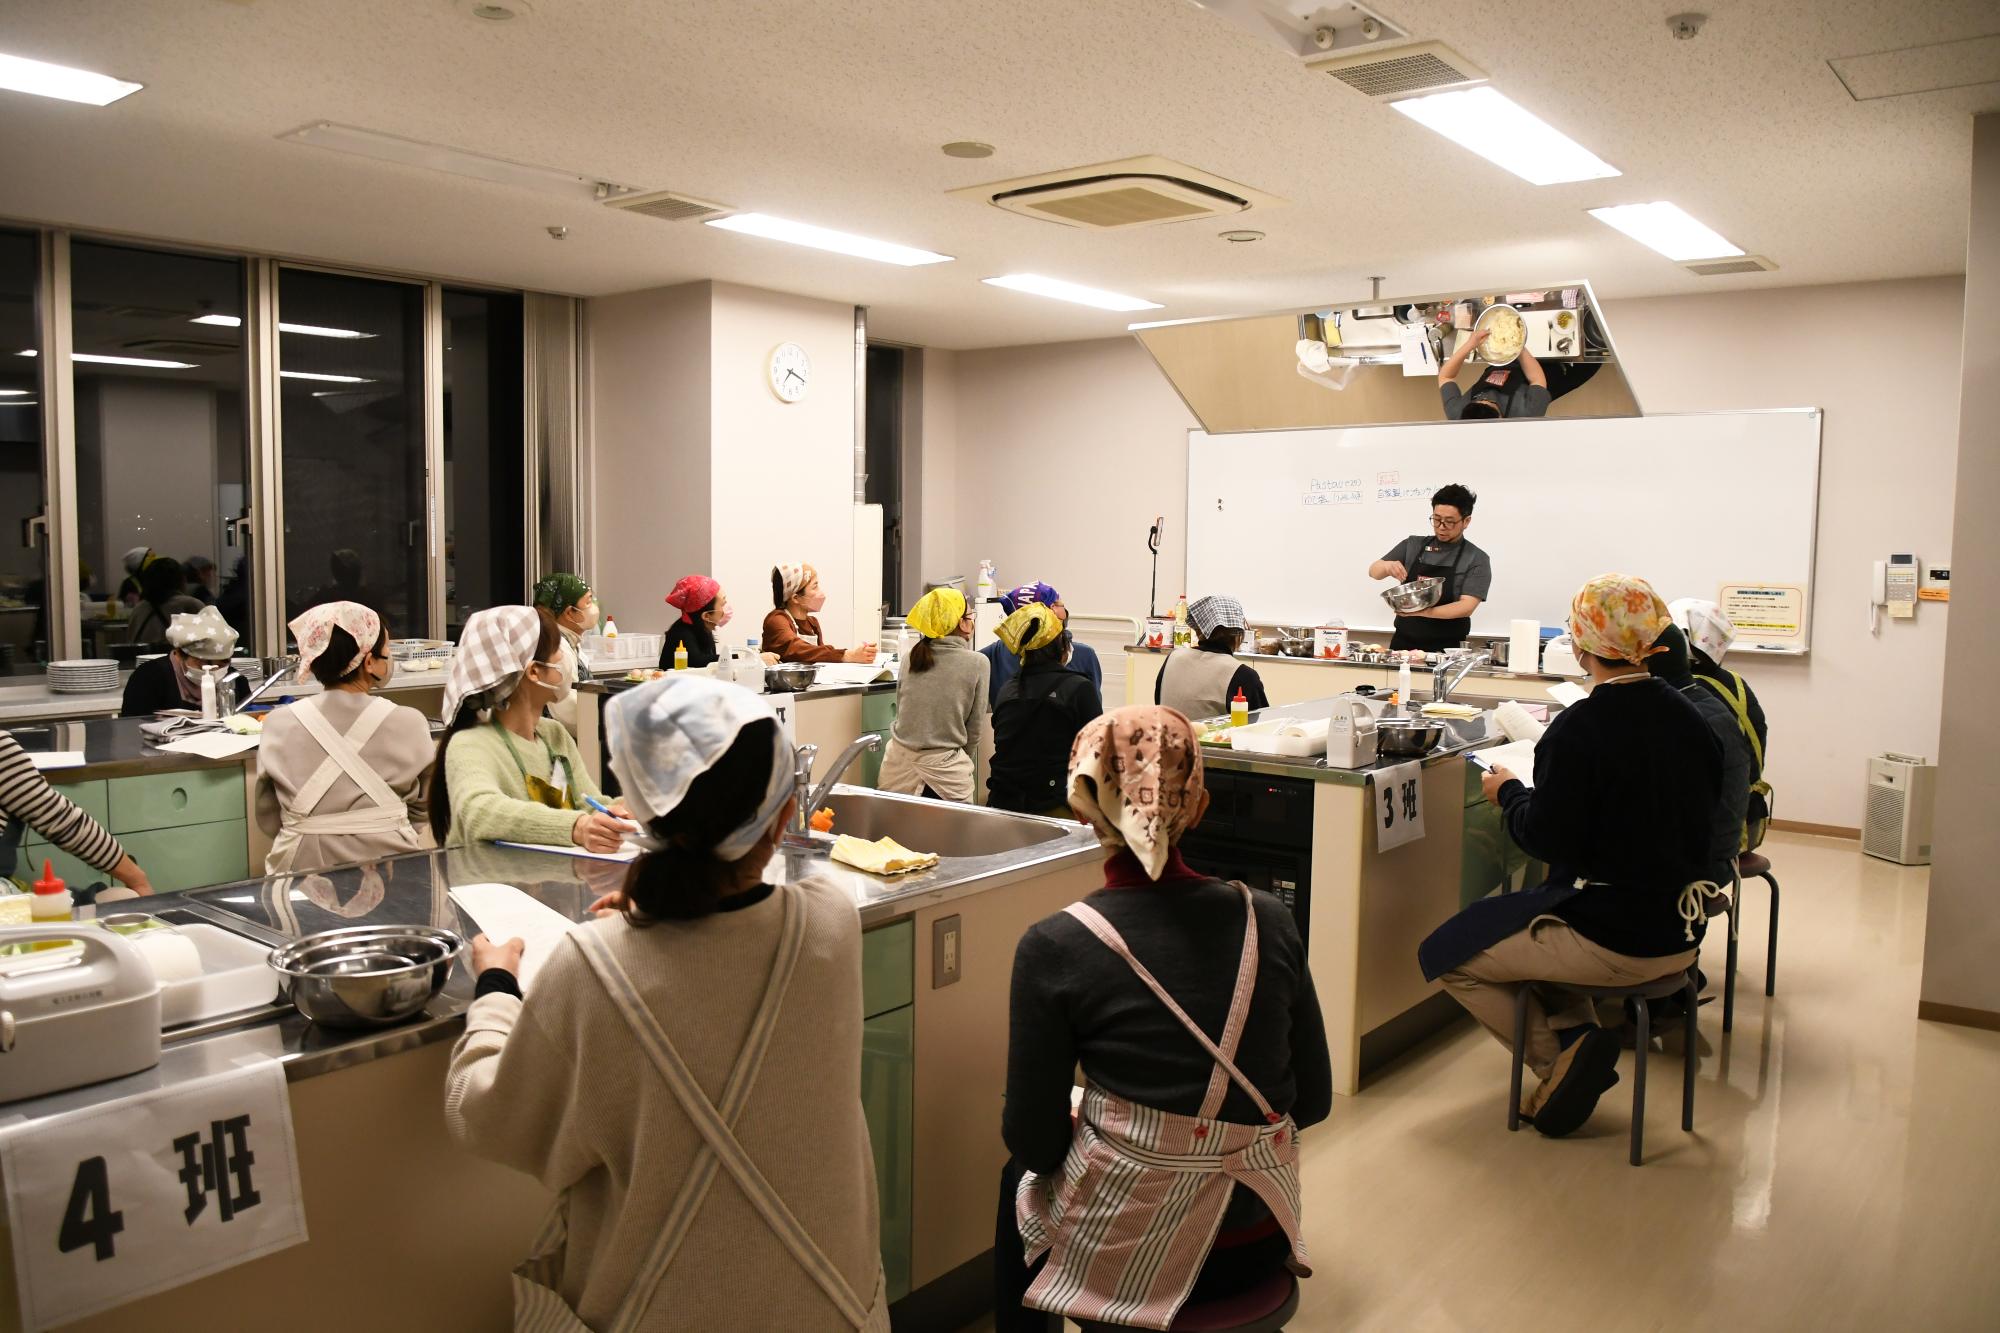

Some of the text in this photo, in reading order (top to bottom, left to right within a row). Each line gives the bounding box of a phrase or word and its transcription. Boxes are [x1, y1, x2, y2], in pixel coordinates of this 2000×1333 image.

[1383, 786, 1394, 829] 3
[58, 1113, 262, 1263] 4 班
